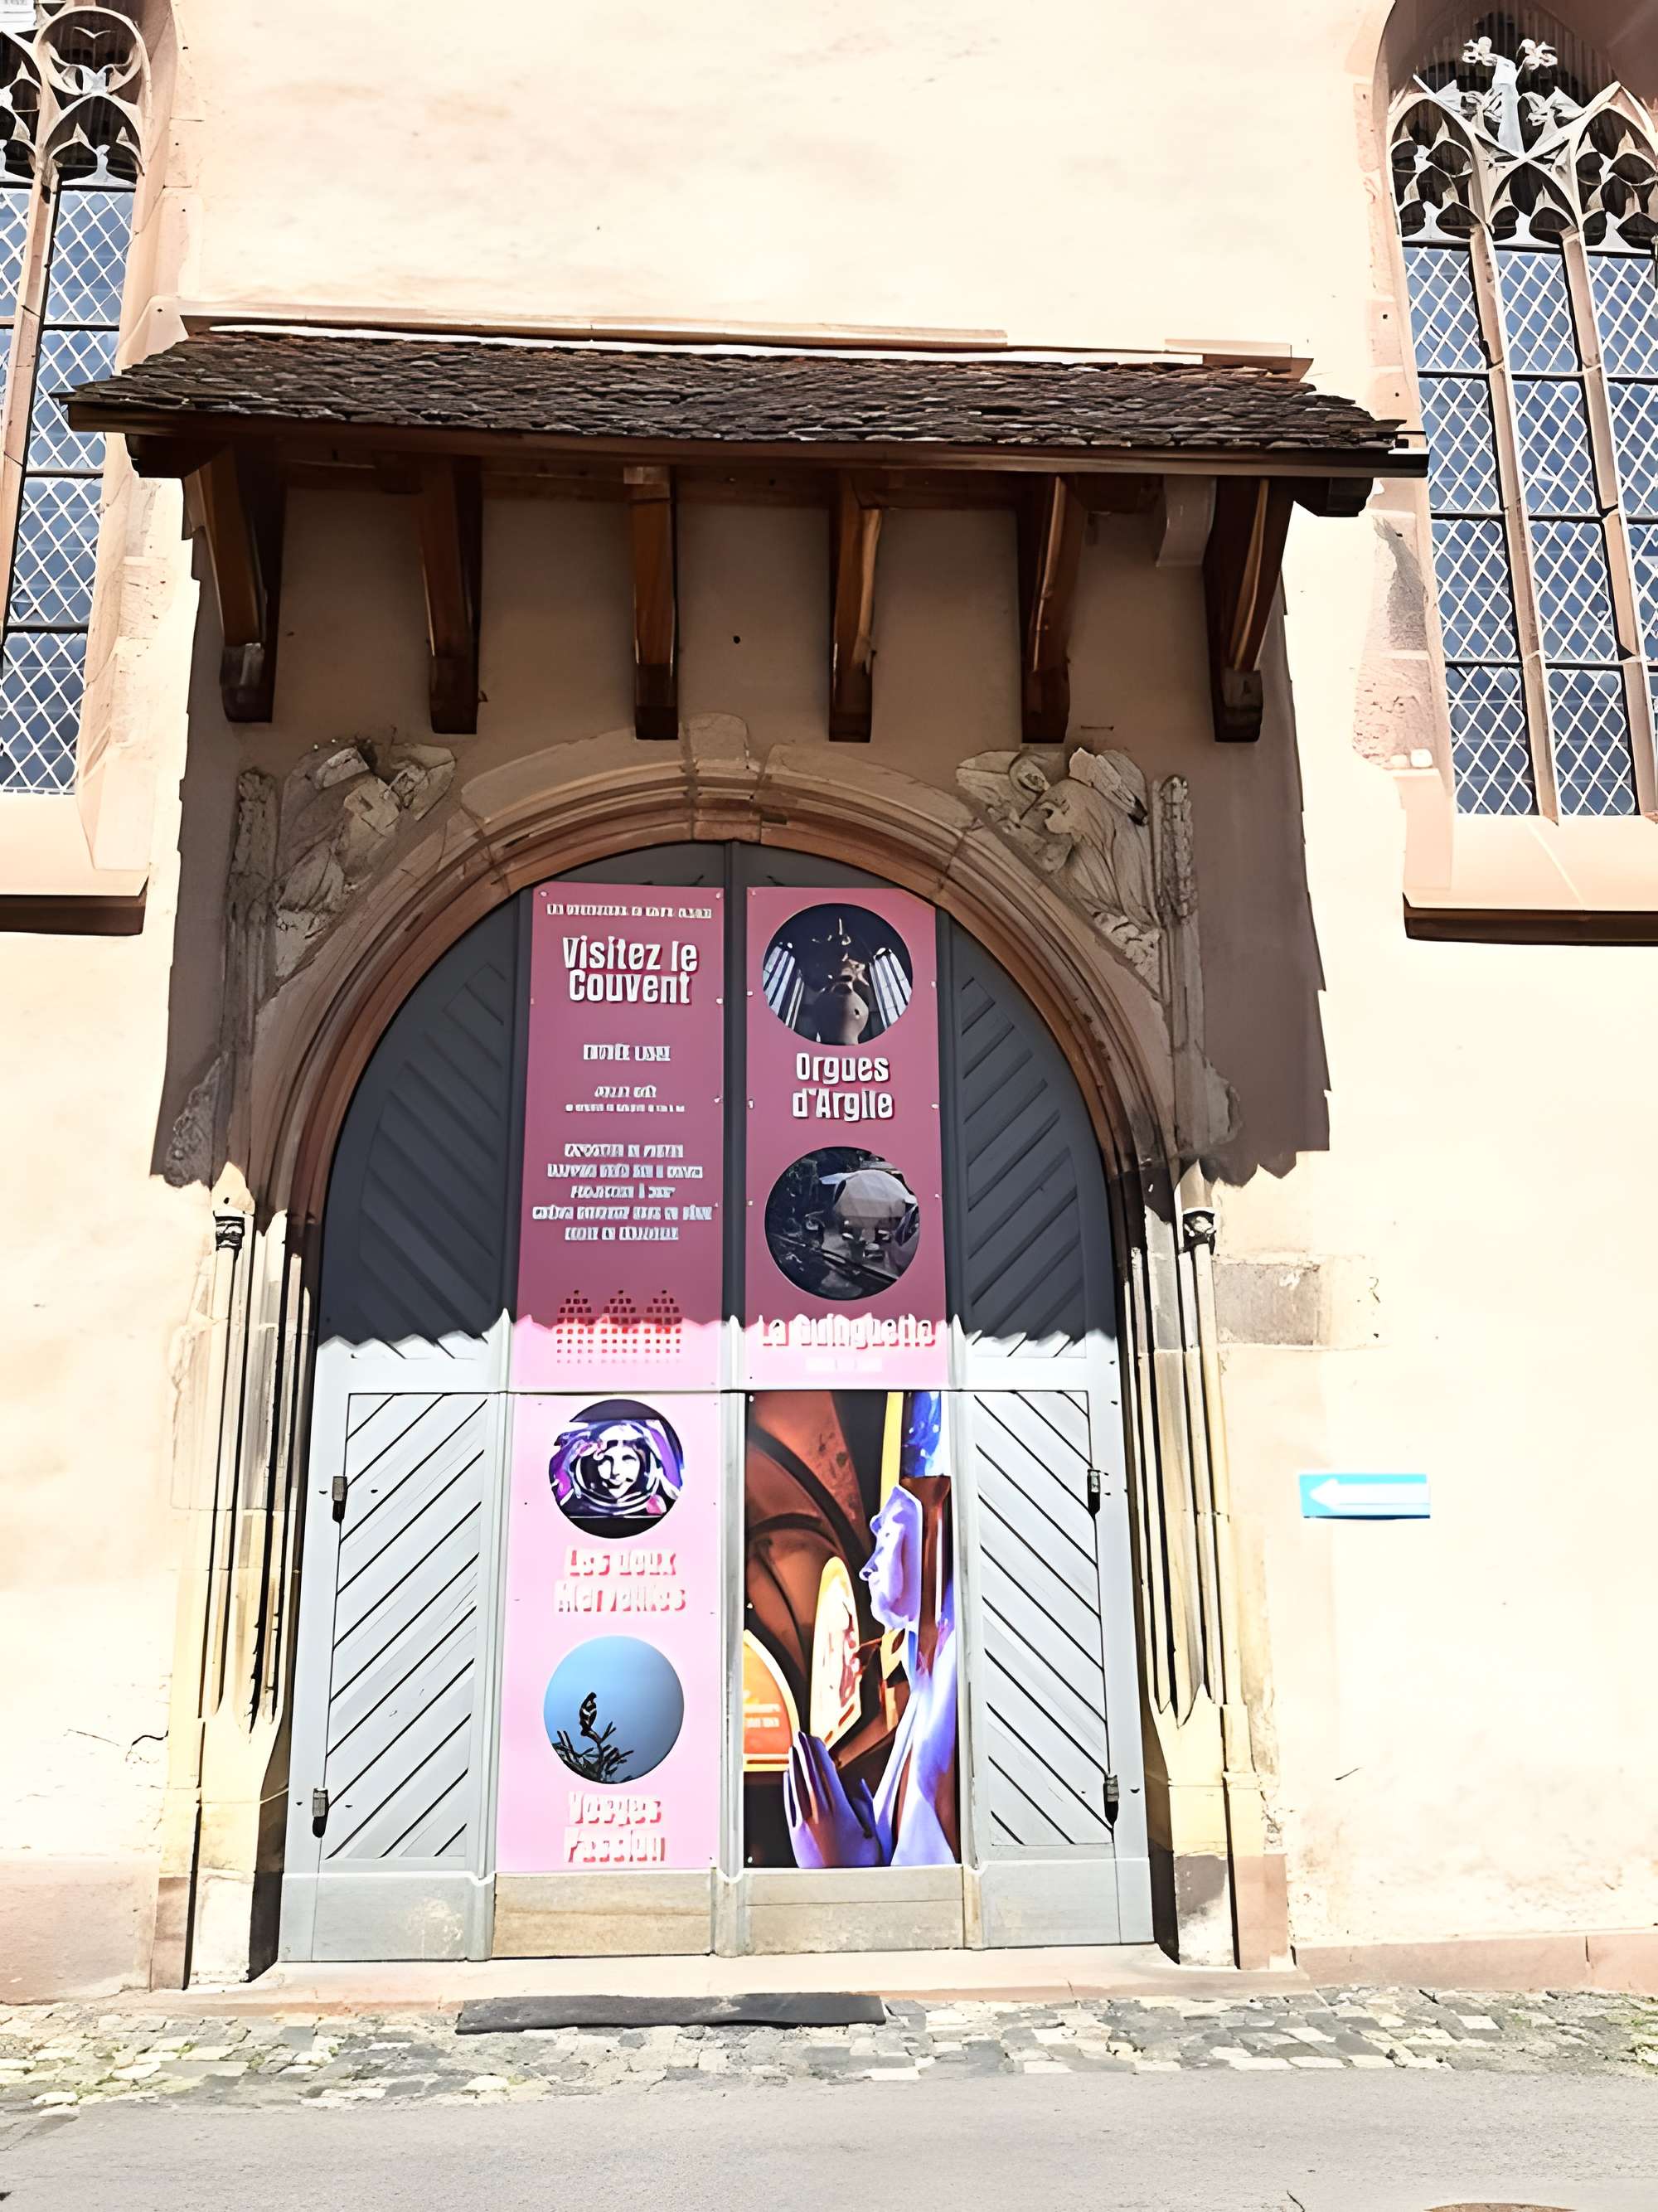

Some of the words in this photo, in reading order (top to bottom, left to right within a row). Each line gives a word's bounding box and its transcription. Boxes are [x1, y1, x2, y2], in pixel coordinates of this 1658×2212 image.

[562, 935, 662, 971] Visitez
[671, 940, 699, 972] le
[569, 968, 691, 1004] Couvent
[796, 1052, 890, 1085] Orgues
[792, 1088, 894, 1122] d'Argile
